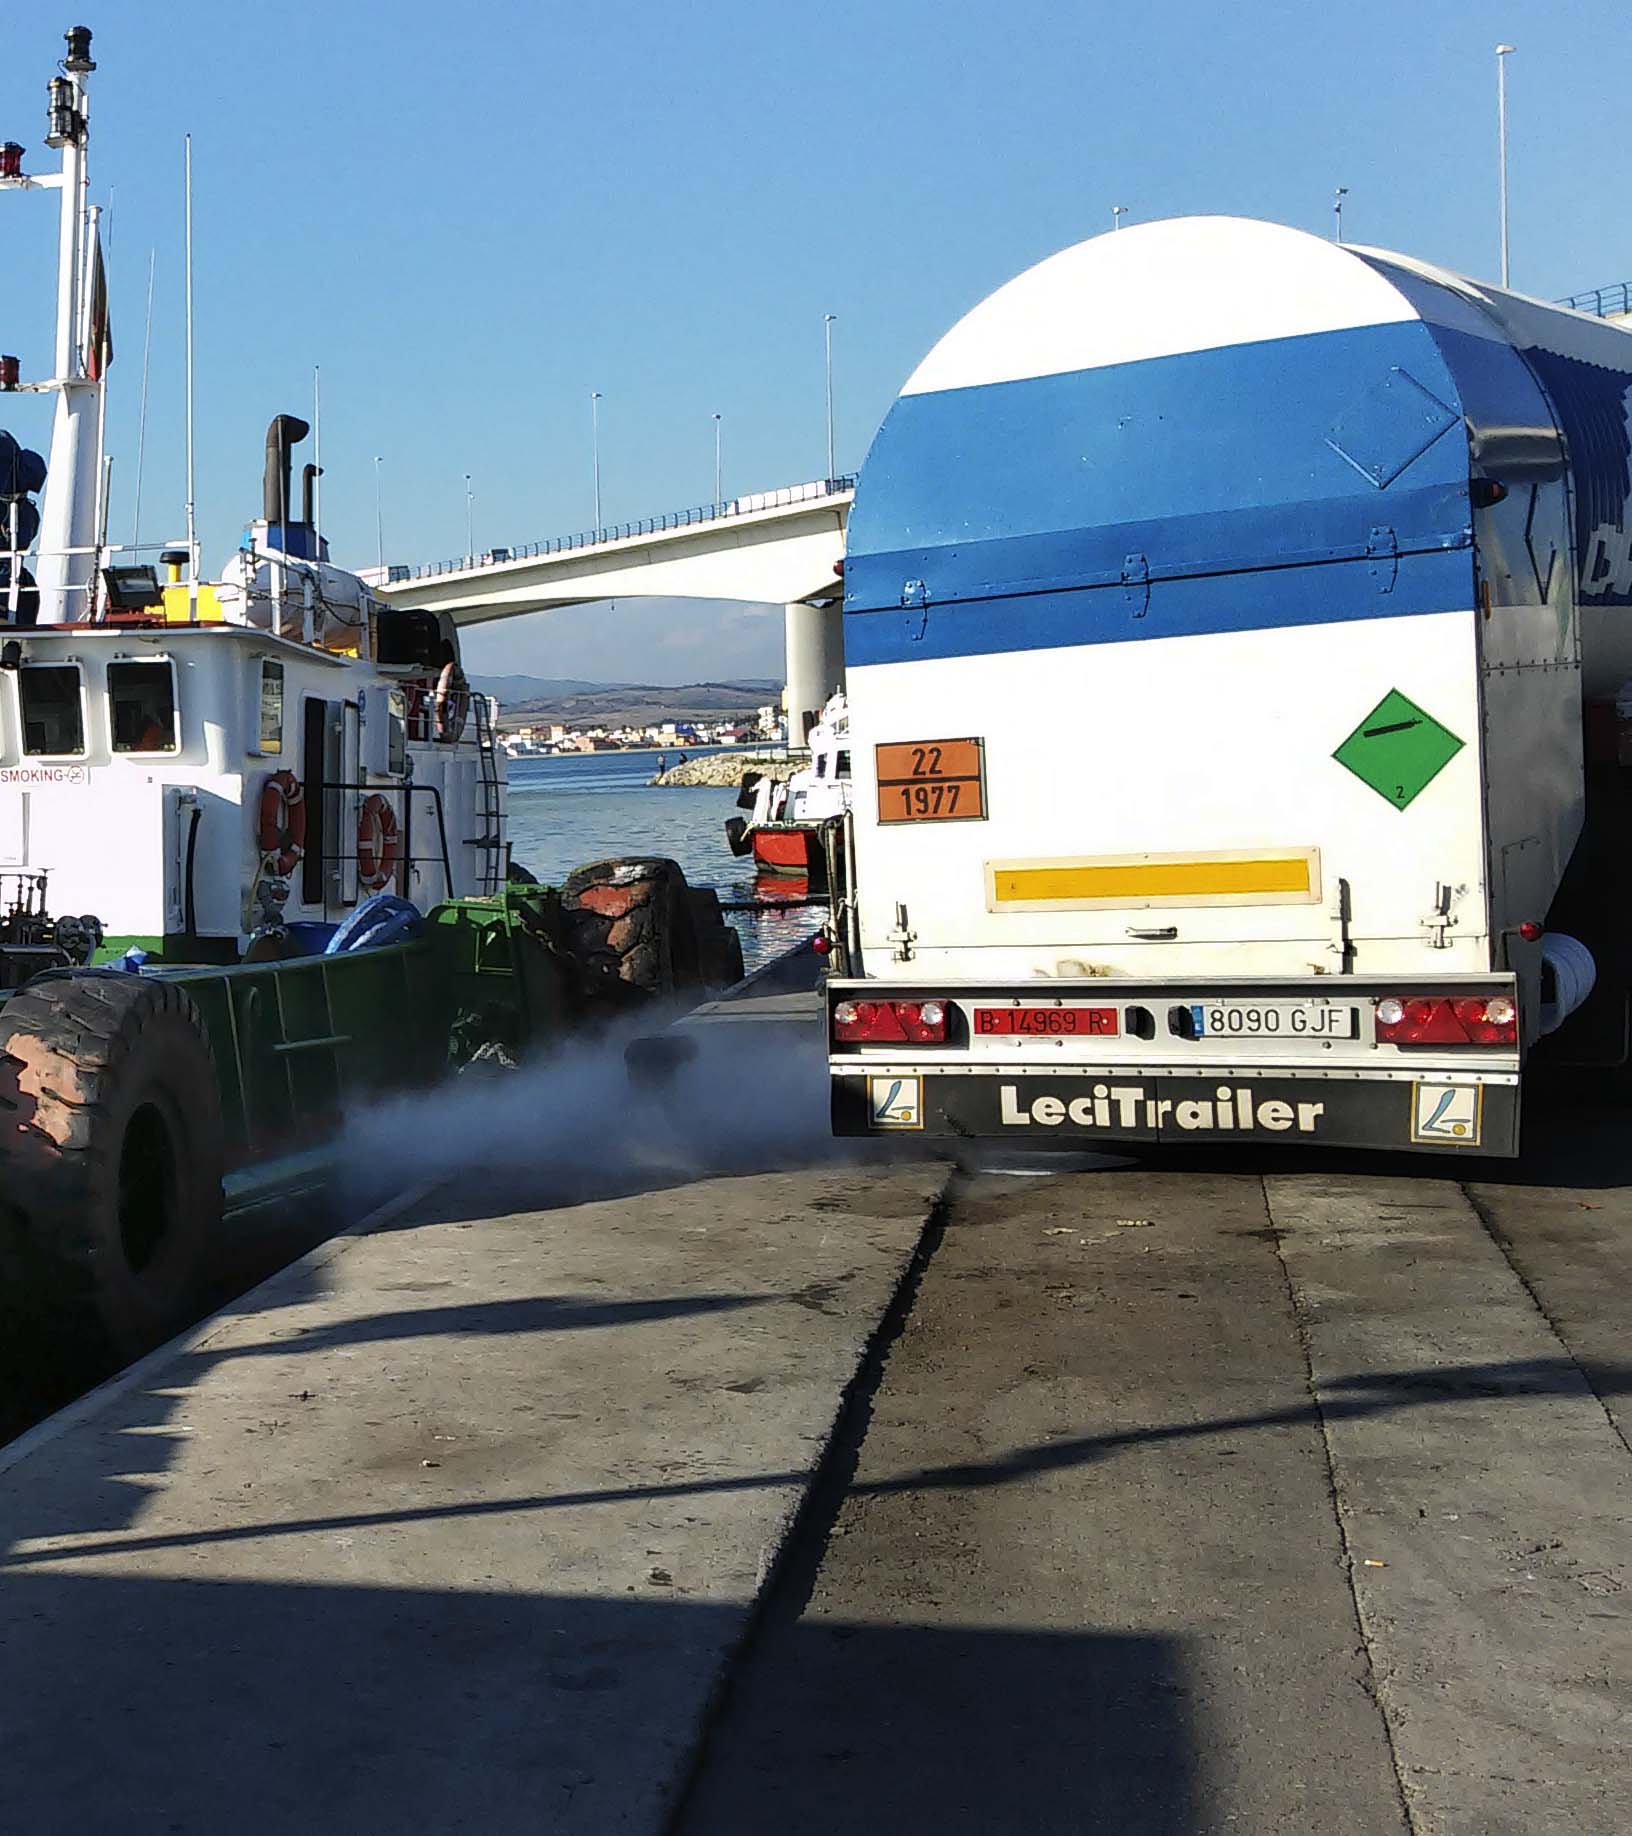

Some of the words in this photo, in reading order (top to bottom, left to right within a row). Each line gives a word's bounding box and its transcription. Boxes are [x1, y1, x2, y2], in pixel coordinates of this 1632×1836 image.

[911, 746, 943, 776] 22
[0, 769, 64, 783] SMOKING
[900, 785, 961, 816] 1977
[1395, 785, 1406, 799] 2
[980, 1011, 995, 1033] B
[1007, 1010, 1077, 1034] 14969
[1088, 1011, 1104, 1034] R
[1210, 1008, 1280, 1033] 8090
[1290, 1008, 1343, 1033] GJF
[999, 1083, 1325, 1133] LeciTrailer
